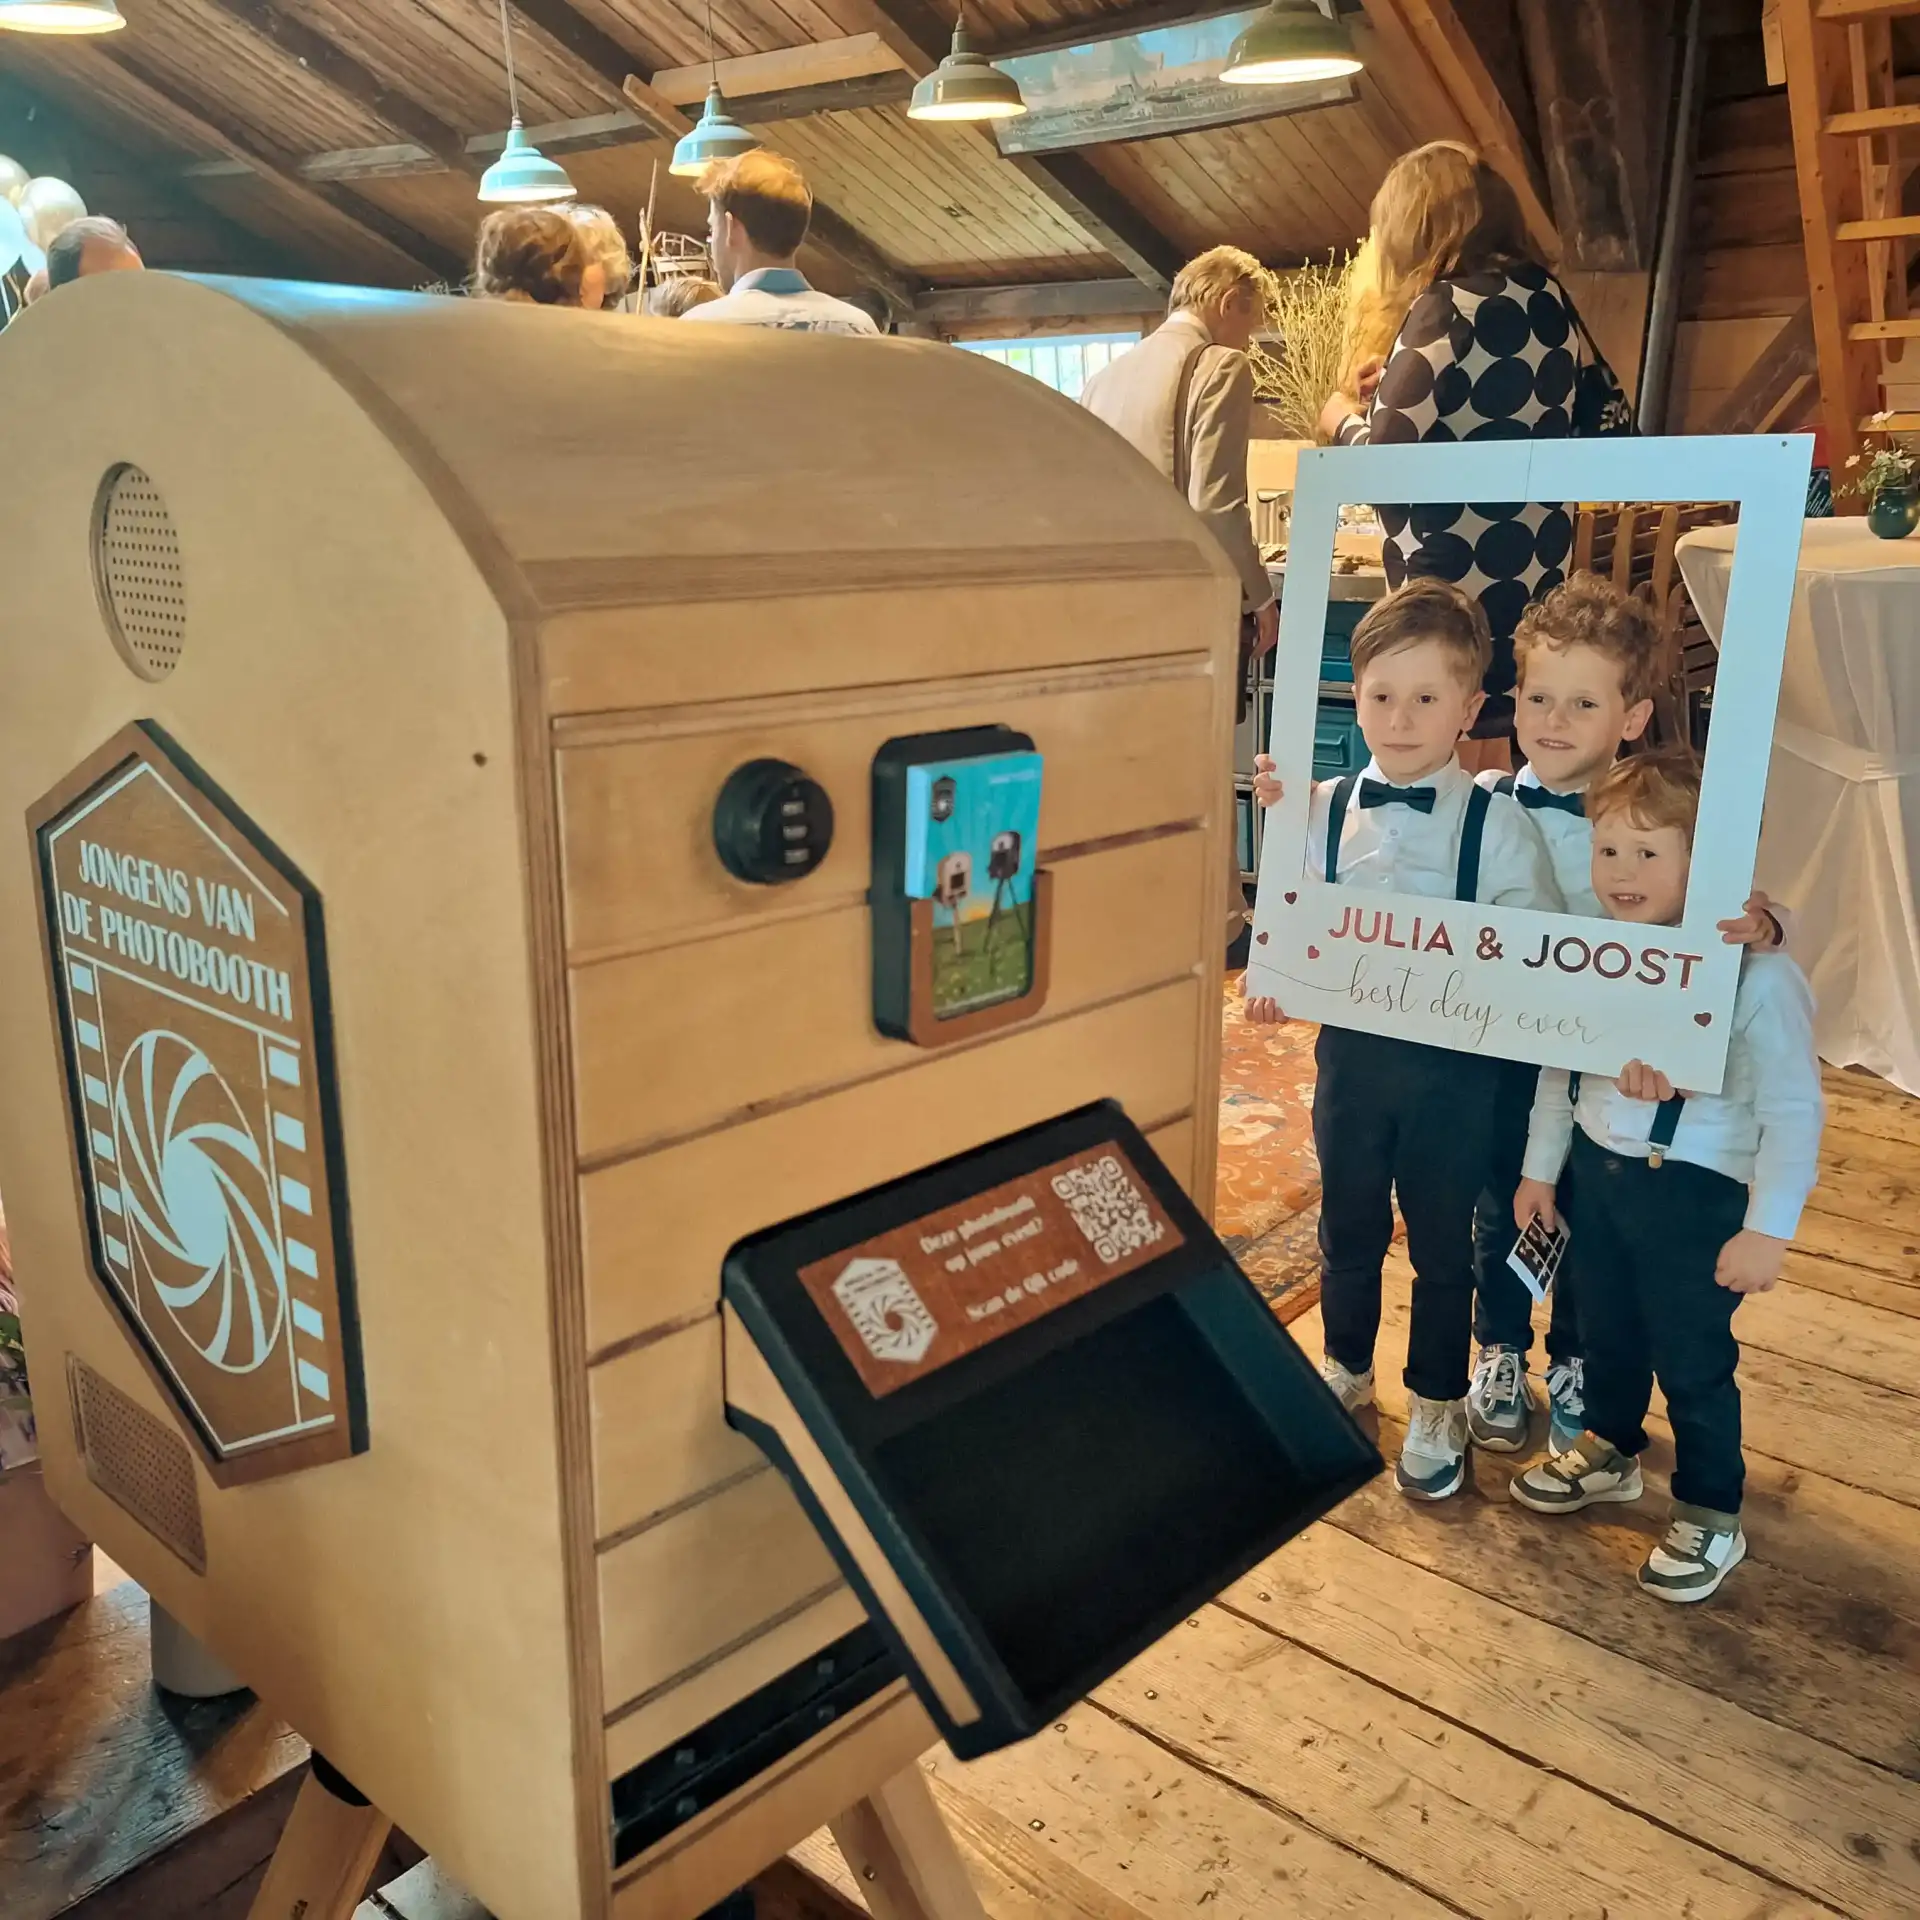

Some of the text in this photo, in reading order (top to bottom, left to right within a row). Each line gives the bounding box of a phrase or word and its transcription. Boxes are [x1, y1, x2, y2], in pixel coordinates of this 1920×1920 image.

[78, 839, 256, 941] JONGENS VAN
[62, 891, 293, 1021] DE PHOTOBOOTH
[1328, 906, 1703, 990] JULIA & JOOST
[1320, 954, 1602, 1047] best day ever
